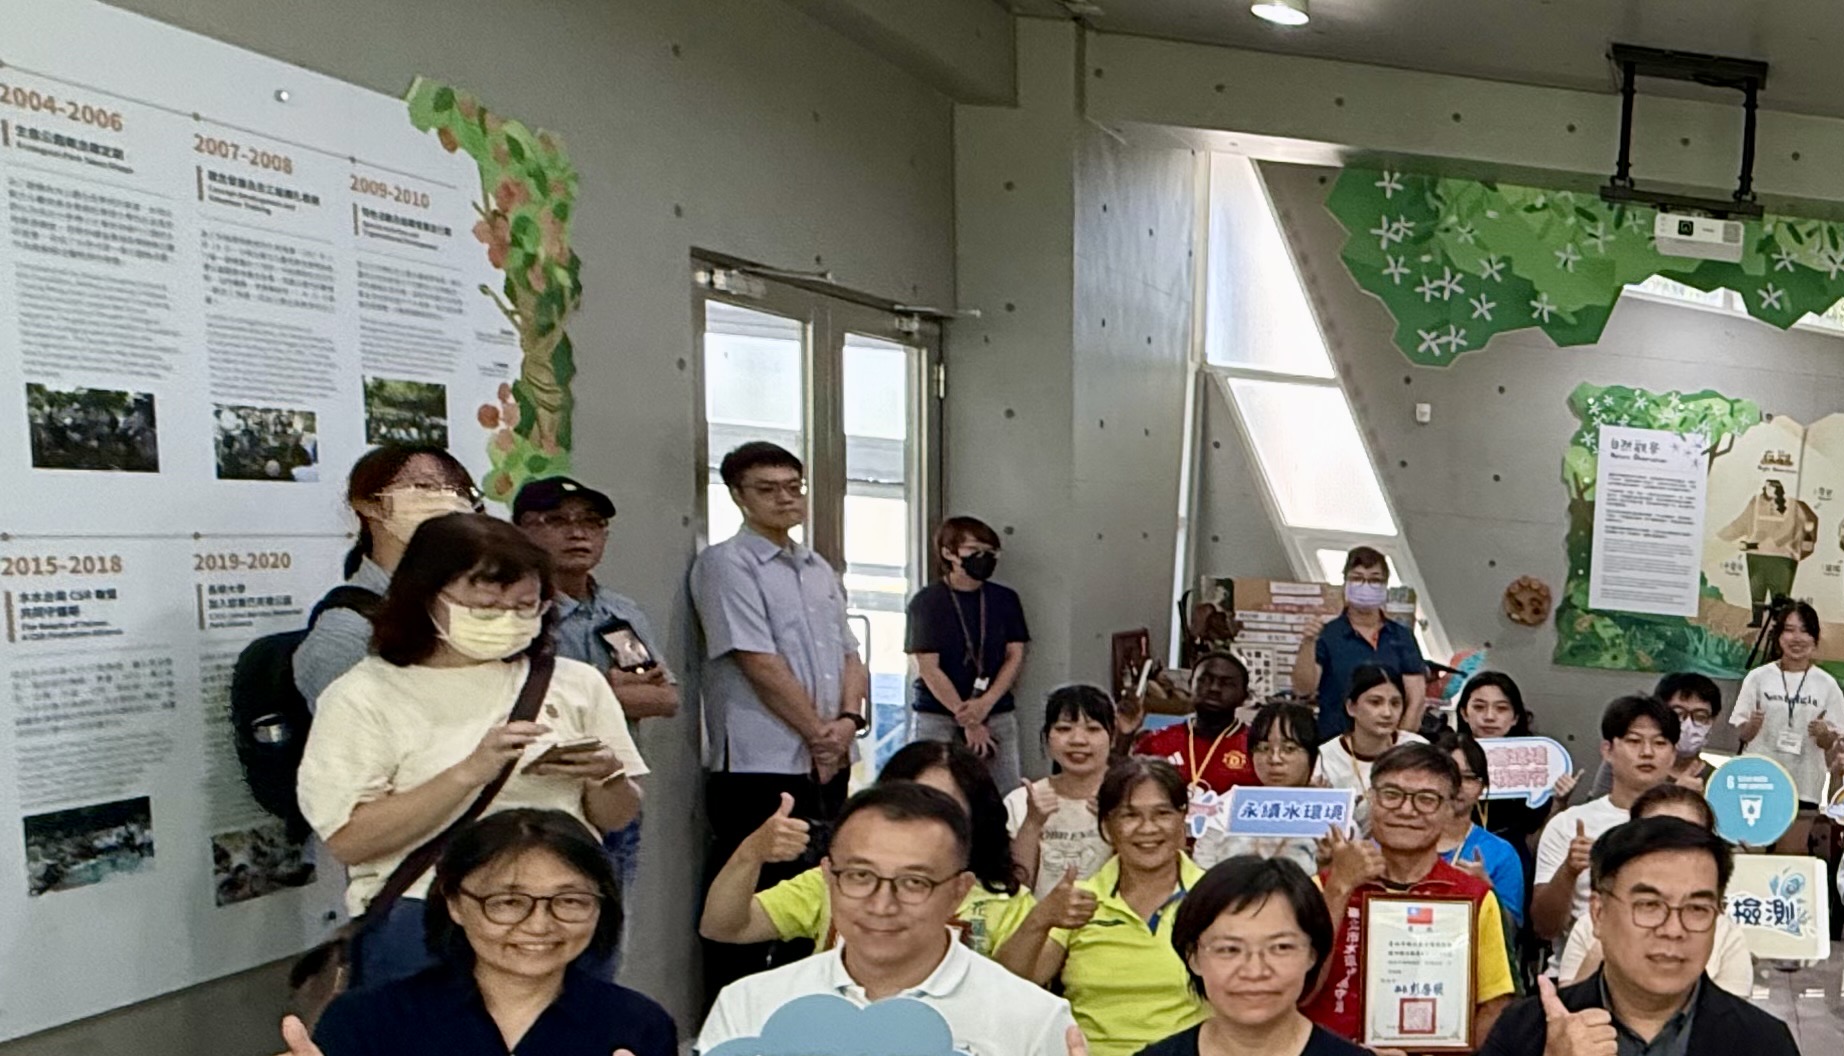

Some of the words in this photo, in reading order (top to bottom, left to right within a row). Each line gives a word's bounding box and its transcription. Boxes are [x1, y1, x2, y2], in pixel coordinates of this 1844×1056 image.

[0, 83, 124, 132] 2004-2006
[194, 133, 293, 175] 2007-2008
[350, 174, 430, 209] 2009-2010
[1, 554, 123, 575] 2015-2018
[194, 552, 291, 571] 2019-2020
[1240, 802, 1343, 820] 永續水環境
[1722, 898, 1797, 926] 檢測
